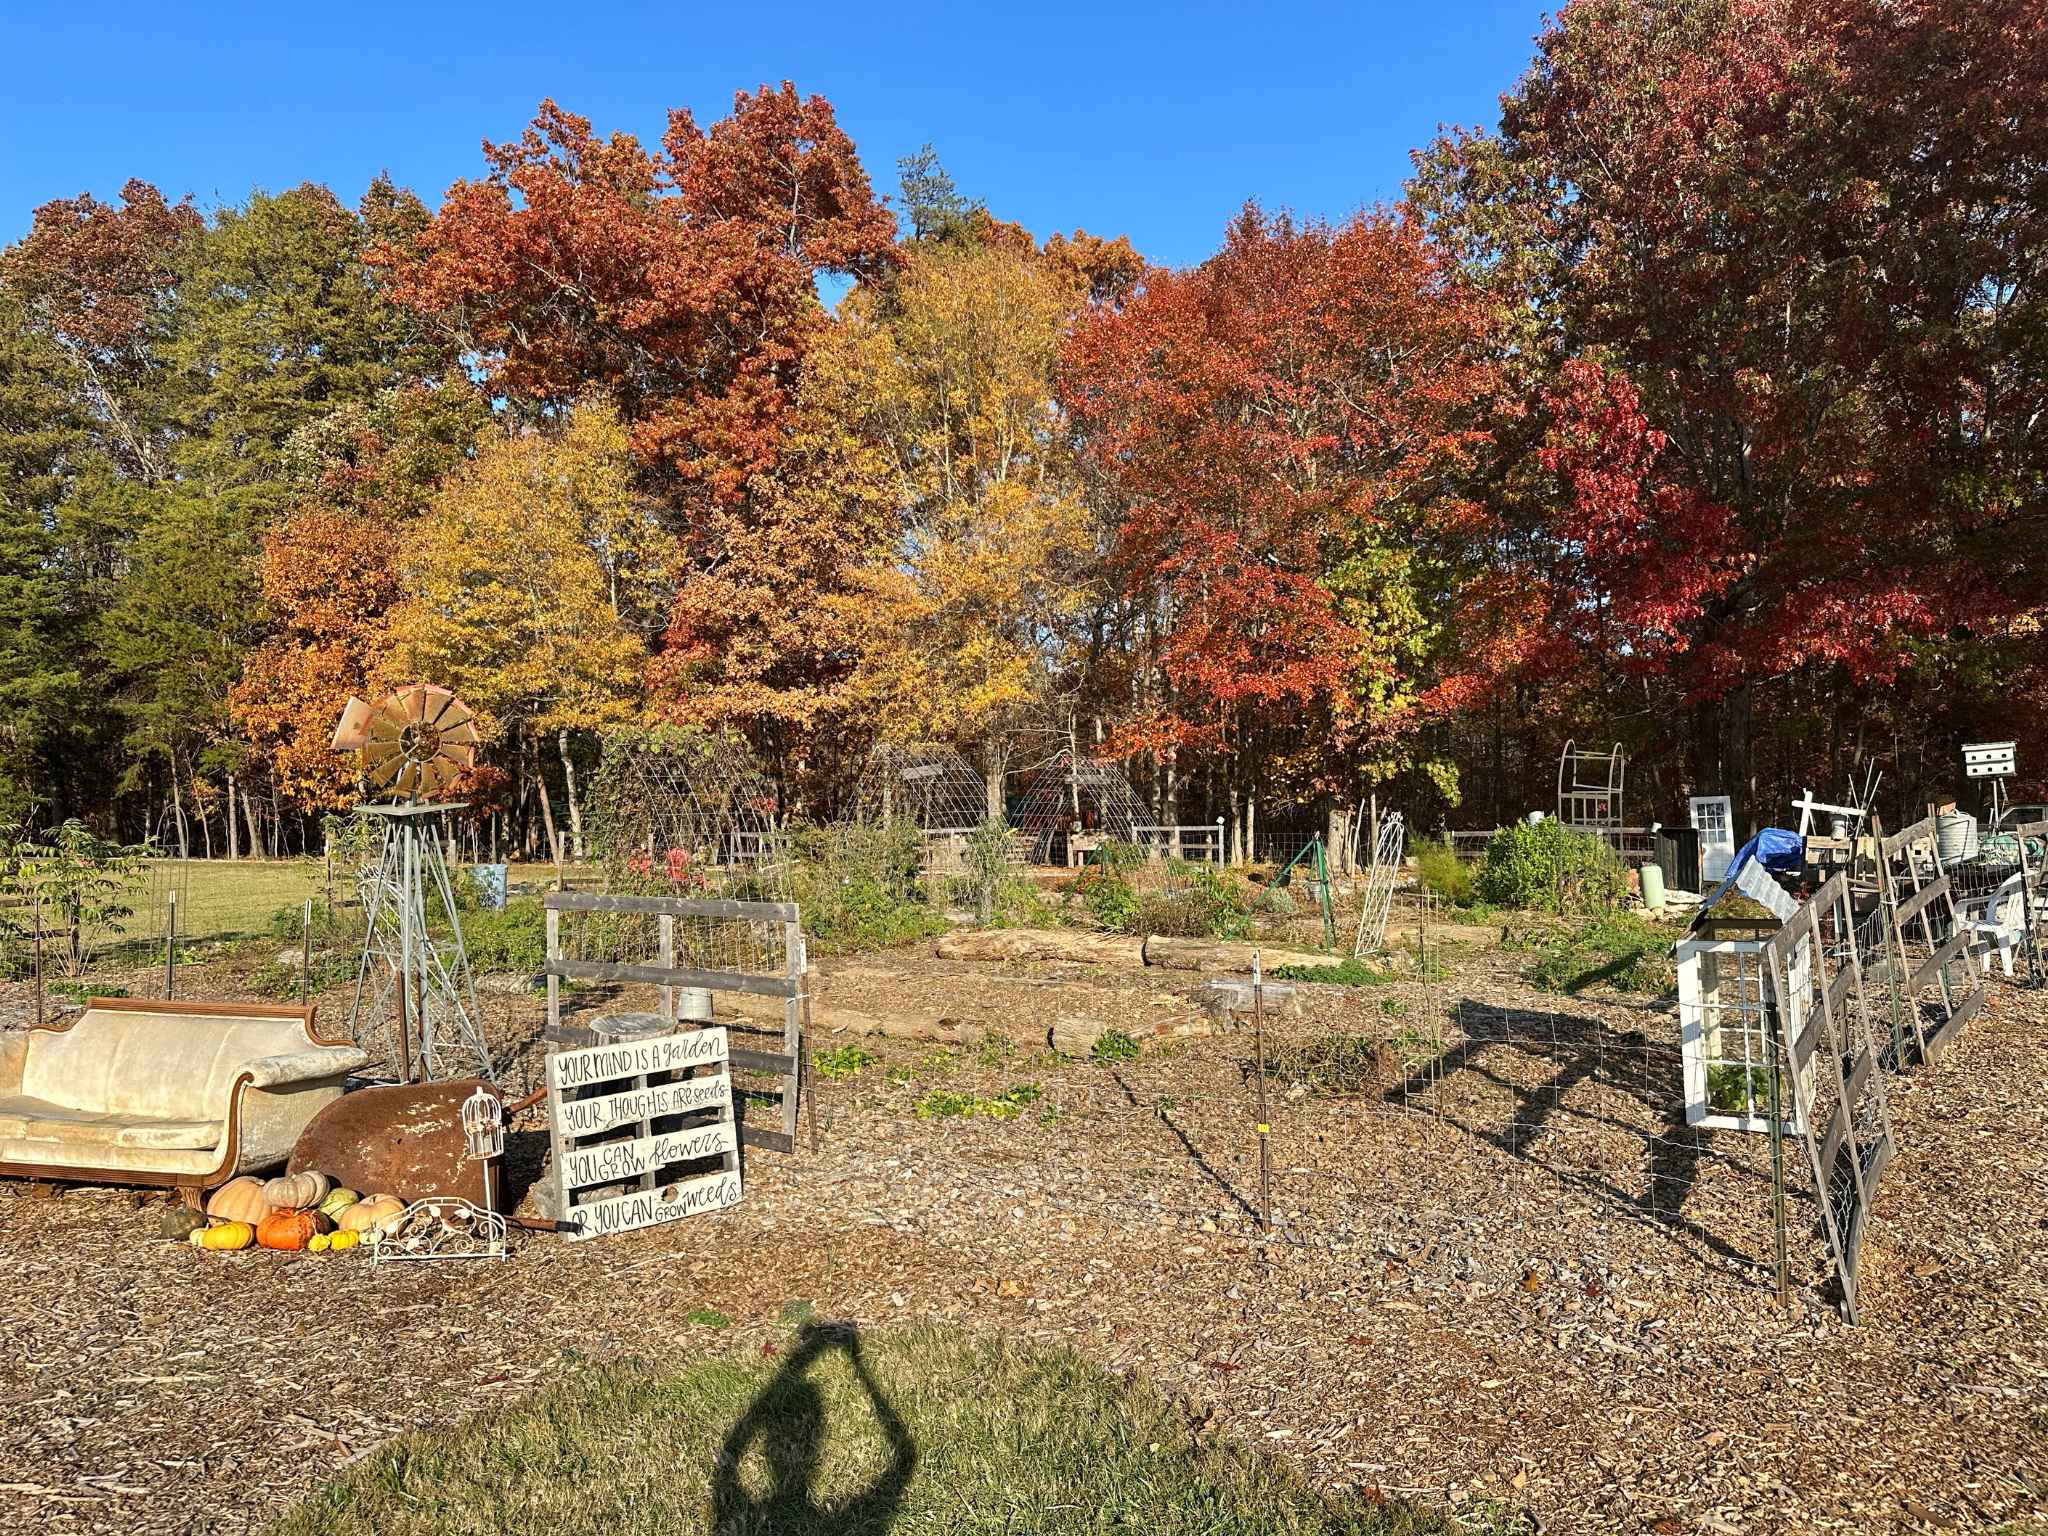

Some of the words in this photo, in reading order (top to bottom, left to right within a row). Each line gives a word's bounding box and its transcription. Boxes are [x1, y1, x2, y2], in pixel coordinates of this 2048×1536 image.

[558, 1054, 593, 1086] YOUR
[636, 1047, 649, 1070] IS
[652, 1044, 661, 1069] A
[662, 1031, 726, 1067] garden
[564, 1101, 603, 1131] YOUR
[693, 1079, 729, 1104] seeds
[603, 1143, 635, 1165] CAN
[649, 1131, 729, 1166] flowers
[569, 1154, 597, 1187] YOU
[598, 1157, 646, 1182] GROW
[594, 1202, 620, 1235] YOU
[620, 1195, 653, 1226] CAN
[655, 1203, 688, 1222] GROW
[682, 1176, 738, 1207] weeds
